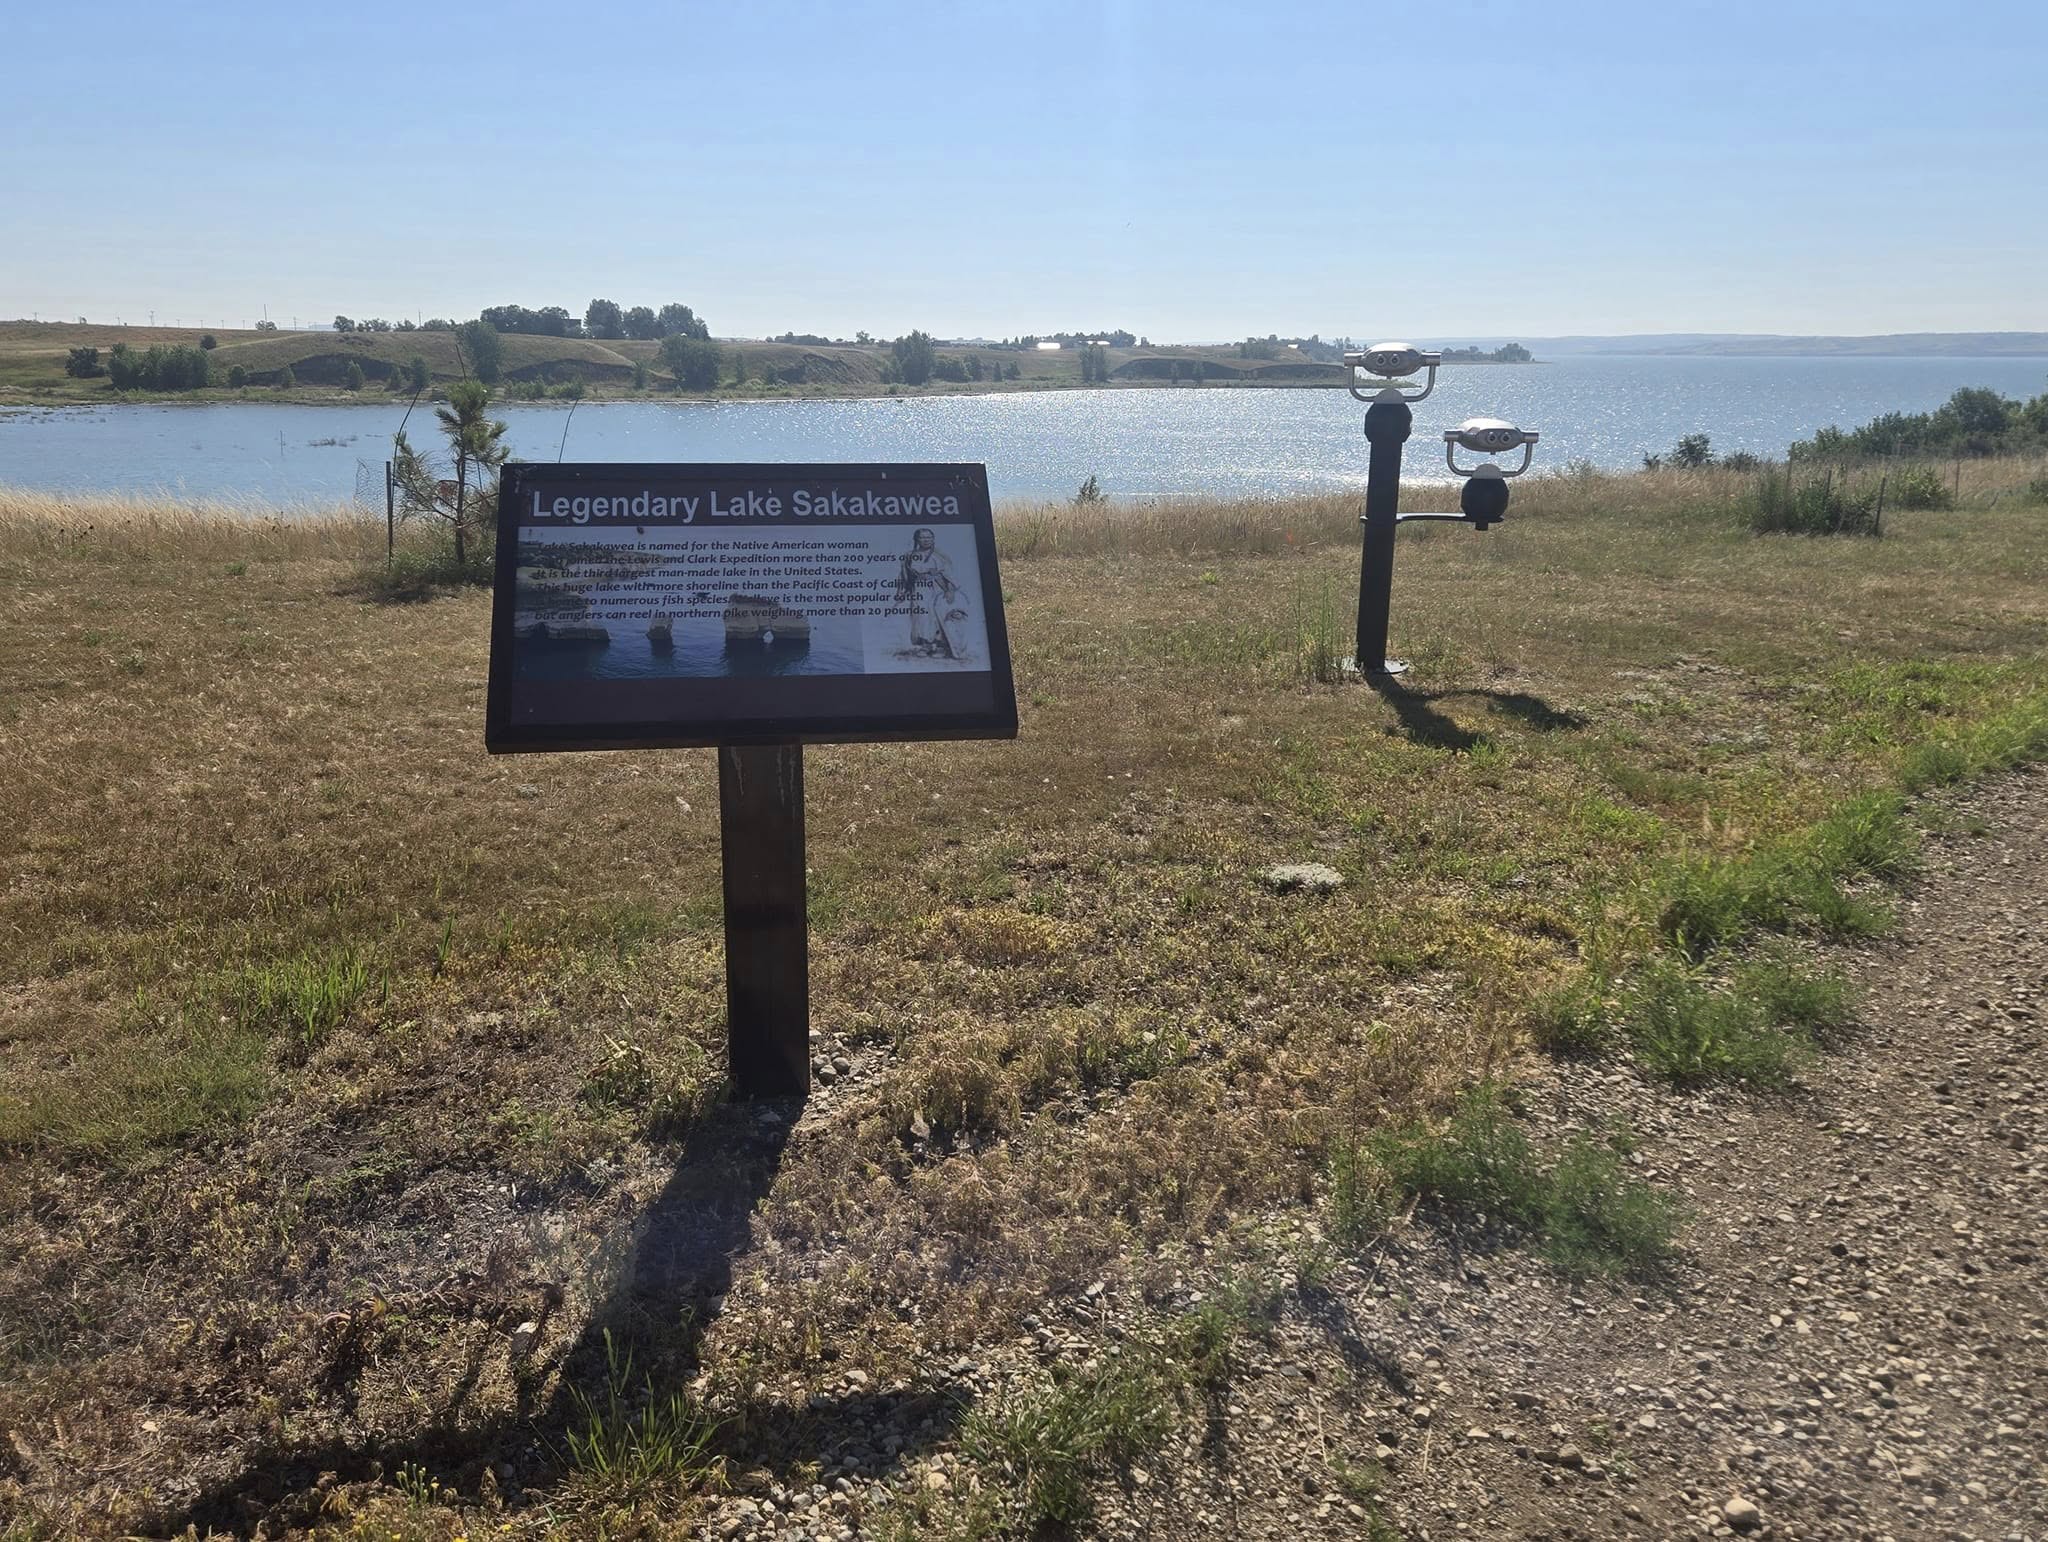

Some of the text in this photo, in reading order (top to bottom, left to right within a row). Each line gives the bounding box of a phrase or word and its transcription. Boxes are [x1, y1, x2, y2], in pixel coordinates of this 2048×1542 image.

[533, 490, 960, 523] Legendary Lake Sakakawea
[568, 542, 634, 551] Sakakawea
[637, 541, 646, 551] is
[649, 541, 689, 551] named
[690, 541, 709, 552] for
[711, 540, 733, 550] the
[732, 540, 770, 550] Native
[771, 540, 825, 550] American
[827, 542, 869, 550] woman
[626, 554, 660, 564] Lewis
[663, 555, 685, 564] and
[687, 554, 718, 564] Clark
[720, 553, 780, 565] Expedition
[816, 553, 842, 563] than
[866, 555, 897, 564] years
[899, 555, 923, 563] ao!
[537, 566, 863, 580] It is the third largest man-made lake in the United States.
[537, 578, 934, 594] This huge lake with more shoreline than the Pacific Coast of Califnia
[584, 597, 598, 605] to
[600, 596, 660, 606] numerous
[662, 595, 684, 606] fish
[687, 594, 730, 606] species.
[783, 594, 792, 603] is
[795, 593, 815, 603] the
[816, 593, 845, 602] most
[847, 592, 891, 604] popular
[893, 591, 924, 602] catch
[558, 609, 602, 622] anglers
[605, 611, 627, 620] can
[629, 609, 652, 619] reel
[655, 608, 666, 618] in
[669, 608, 721, 619] northern
[723, 608, 748, 620] pike
[751, 606, 804, 620] weighing
[806, 608, 838, 617] more
[840, 606, 866, 616] than
[869, 608, 881, 616] 20
[883, 604, 929, 617] pounds.
